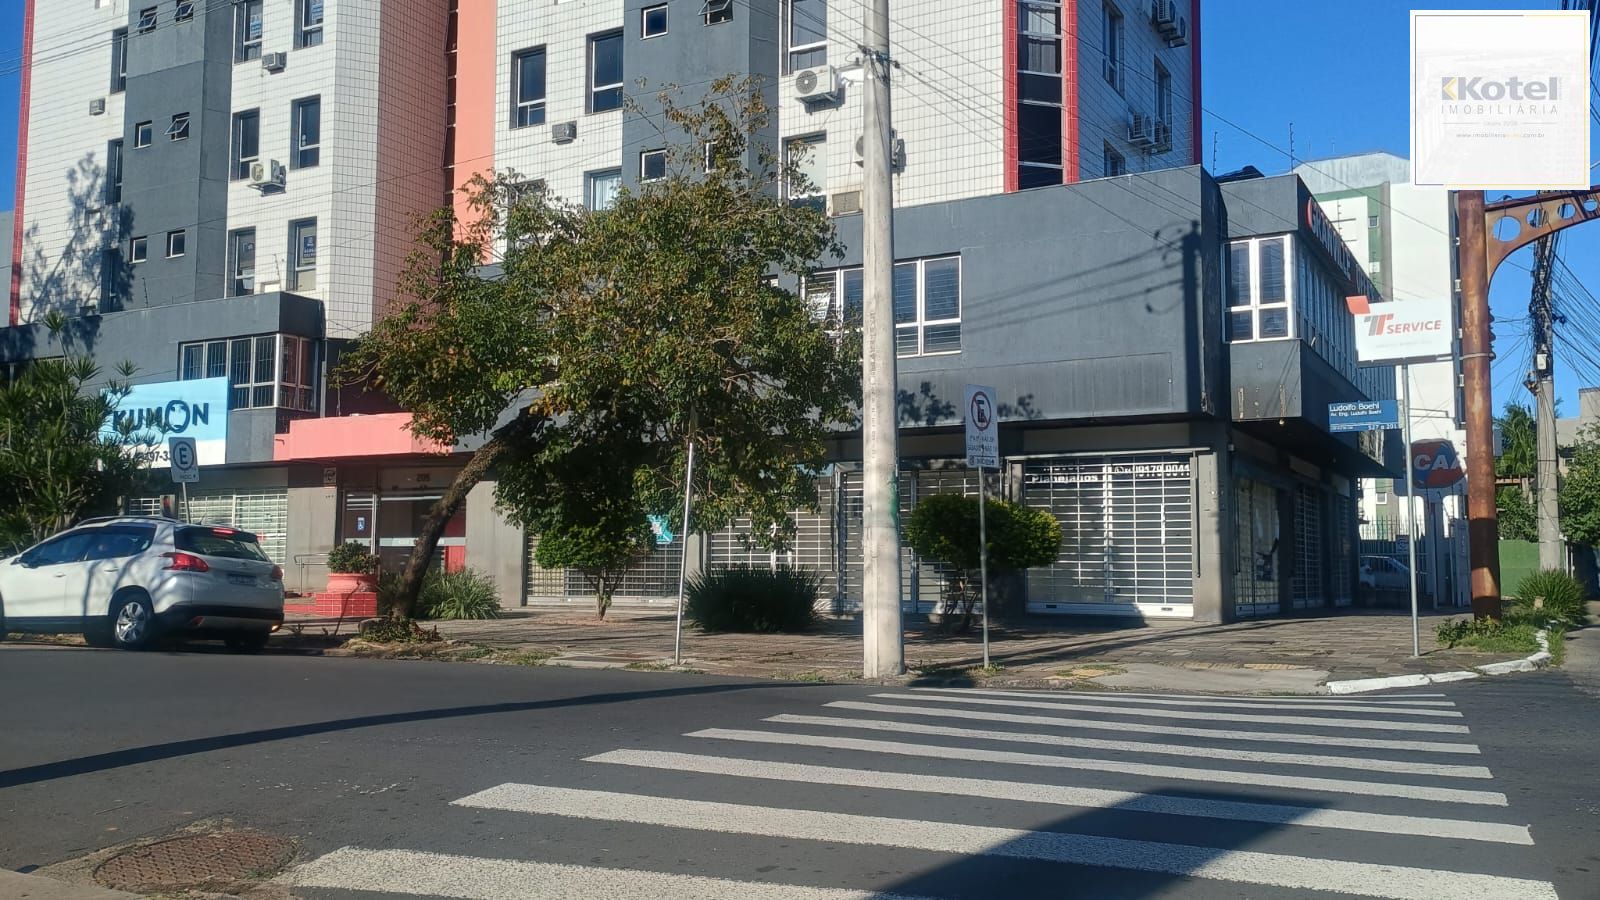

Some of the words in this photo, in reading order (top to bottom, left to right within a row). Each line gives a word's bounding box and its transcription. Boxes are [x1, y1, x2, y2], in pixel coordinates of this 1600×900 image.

[1387, 320, 1442, 334] SERVICE
[1329, 403, 1356, 412] Ludolfo
[1359, 401, 1380, 410] Boehl
[112, 399, 209, 434] KUMON
[179, 447, 188, 465] E
